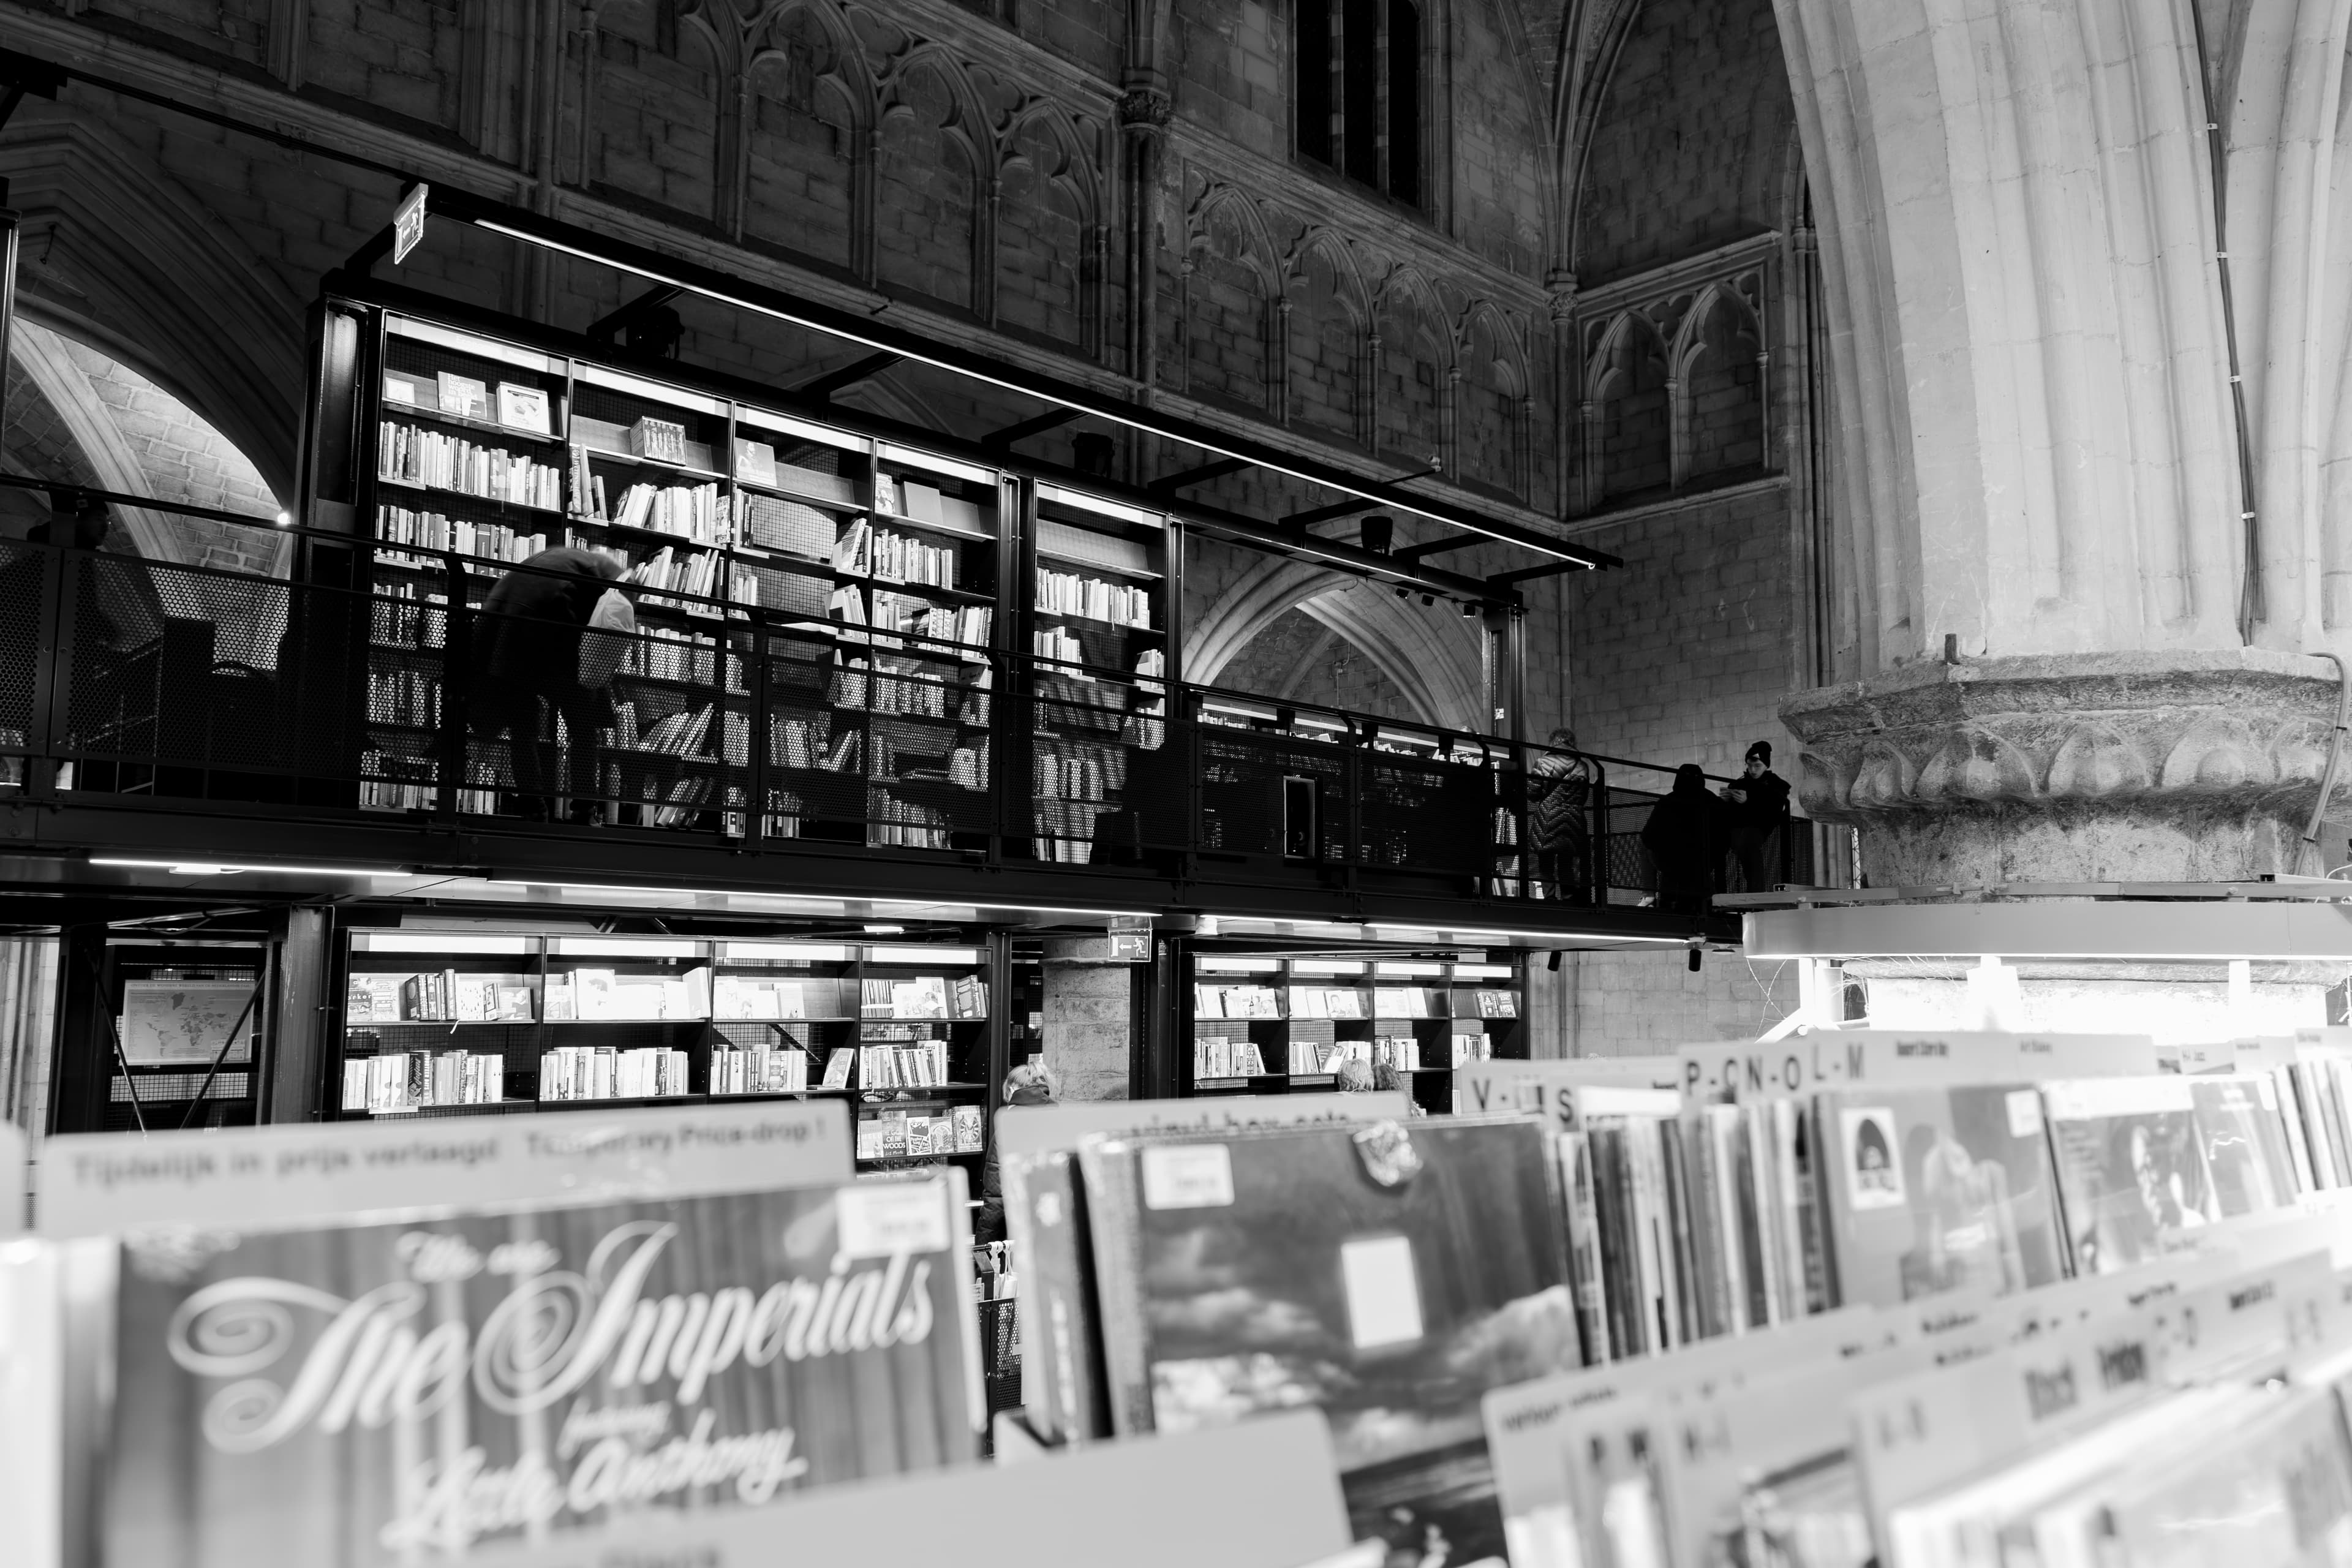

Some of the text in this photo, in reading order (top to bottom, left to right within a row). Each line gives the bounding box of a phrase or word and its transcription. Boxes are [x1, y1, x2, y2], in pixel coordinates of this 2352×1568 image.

[448, 374, 460, 382] Het
[1684, 1058, 1700, 1096] P
[1746, 1054, 1763, 1092] N
[1812, 1042, 1826, 1081] L
[1847, 1042, 1864, 1080] M
[1471, 1077, 1491, 1110] V
[1558, 1087, 1573, 1123] S
[679, 1119, 809, 1147] Price-drop
[71, 1134, 500, 1187] Tijdelijk in prijs verlaagd
[167, 1219, 934, 1453] The Imperials
[567, 1409, 810, 1515] Anthony
